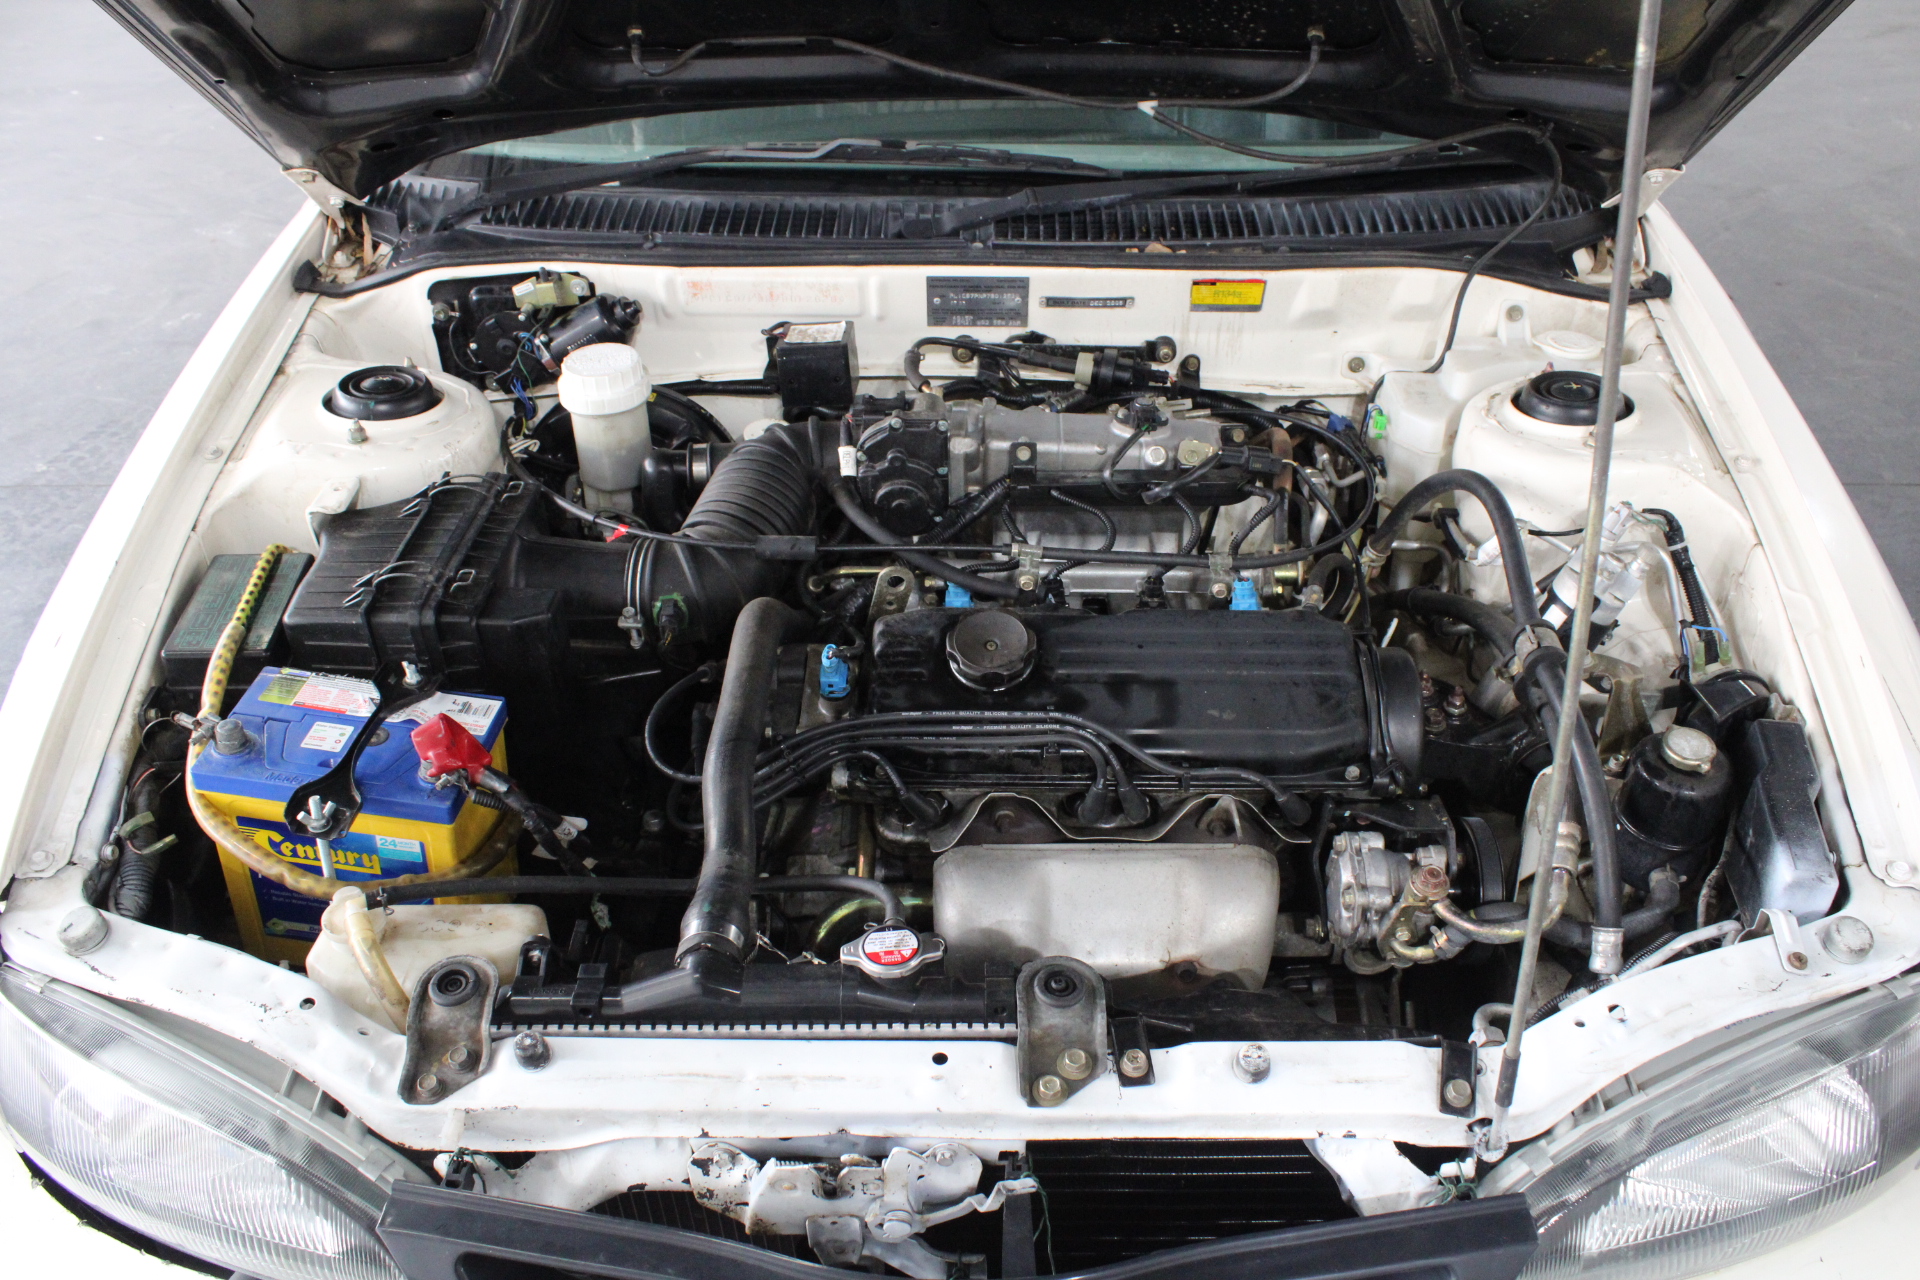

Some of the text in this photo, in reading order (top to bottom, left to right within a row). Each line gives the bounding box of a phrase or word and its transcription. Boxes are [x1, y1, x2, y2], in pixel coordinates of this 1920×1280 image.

[1213, 289, 1243, 298] R134a
[1065, 713, 1083, 722] CABLE
[264, 771, 303, 785] Made
[378, 837, 399, 849] 24
[247, 828, 382, 875] Cenury
